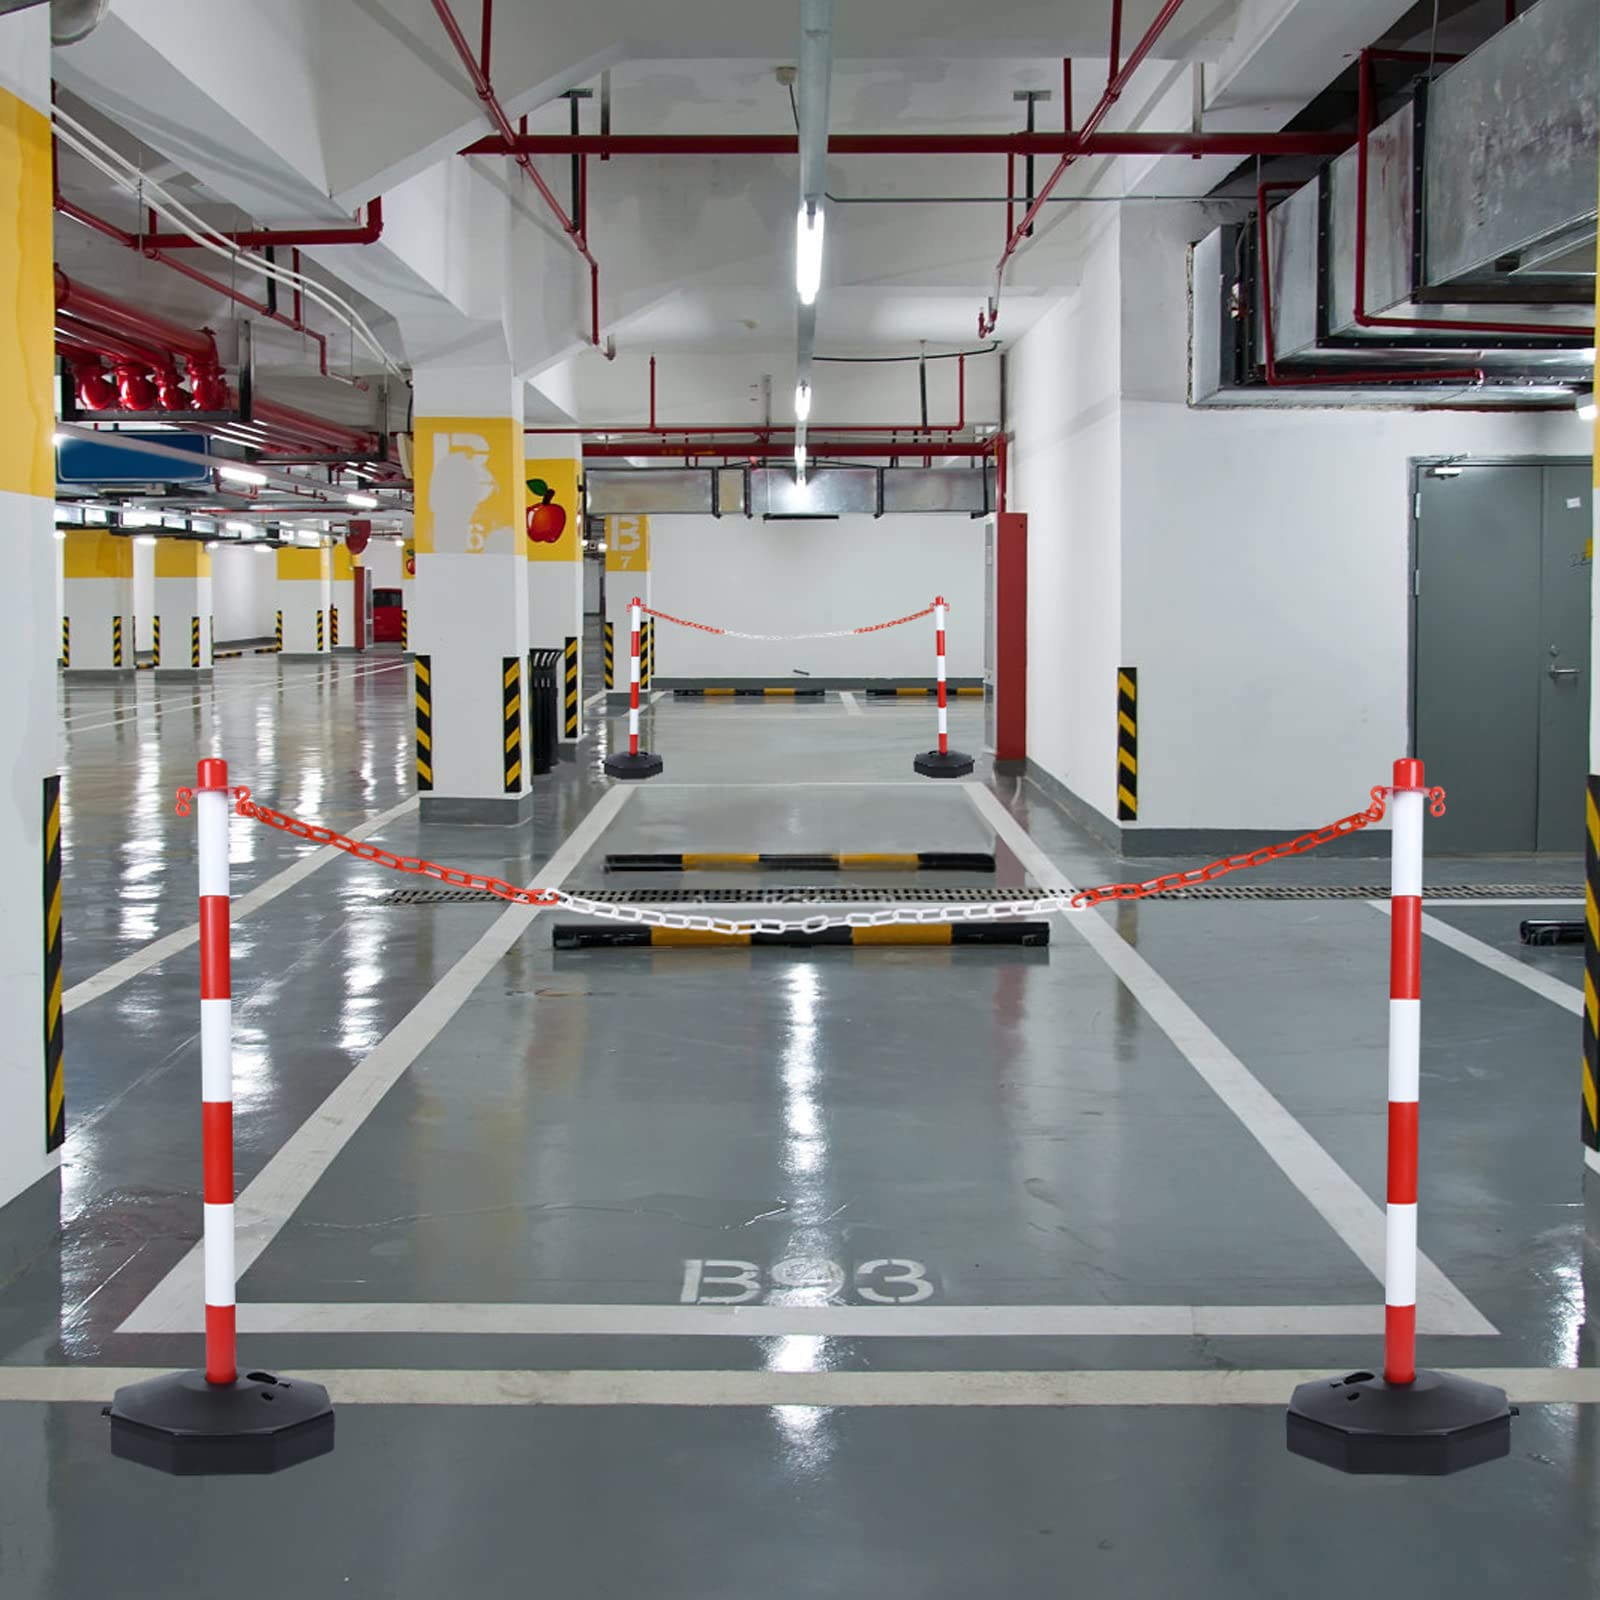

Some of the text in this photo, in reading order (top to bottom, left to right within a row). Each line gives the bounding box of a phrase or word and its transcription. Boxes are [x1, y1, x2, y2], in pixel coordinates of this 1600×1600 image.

[468, 523, 486, 549] 6
[611, 514, 641, 551] B
[620, 555, 632, 570] 7
[680, 1258, 934, 1303] B93
